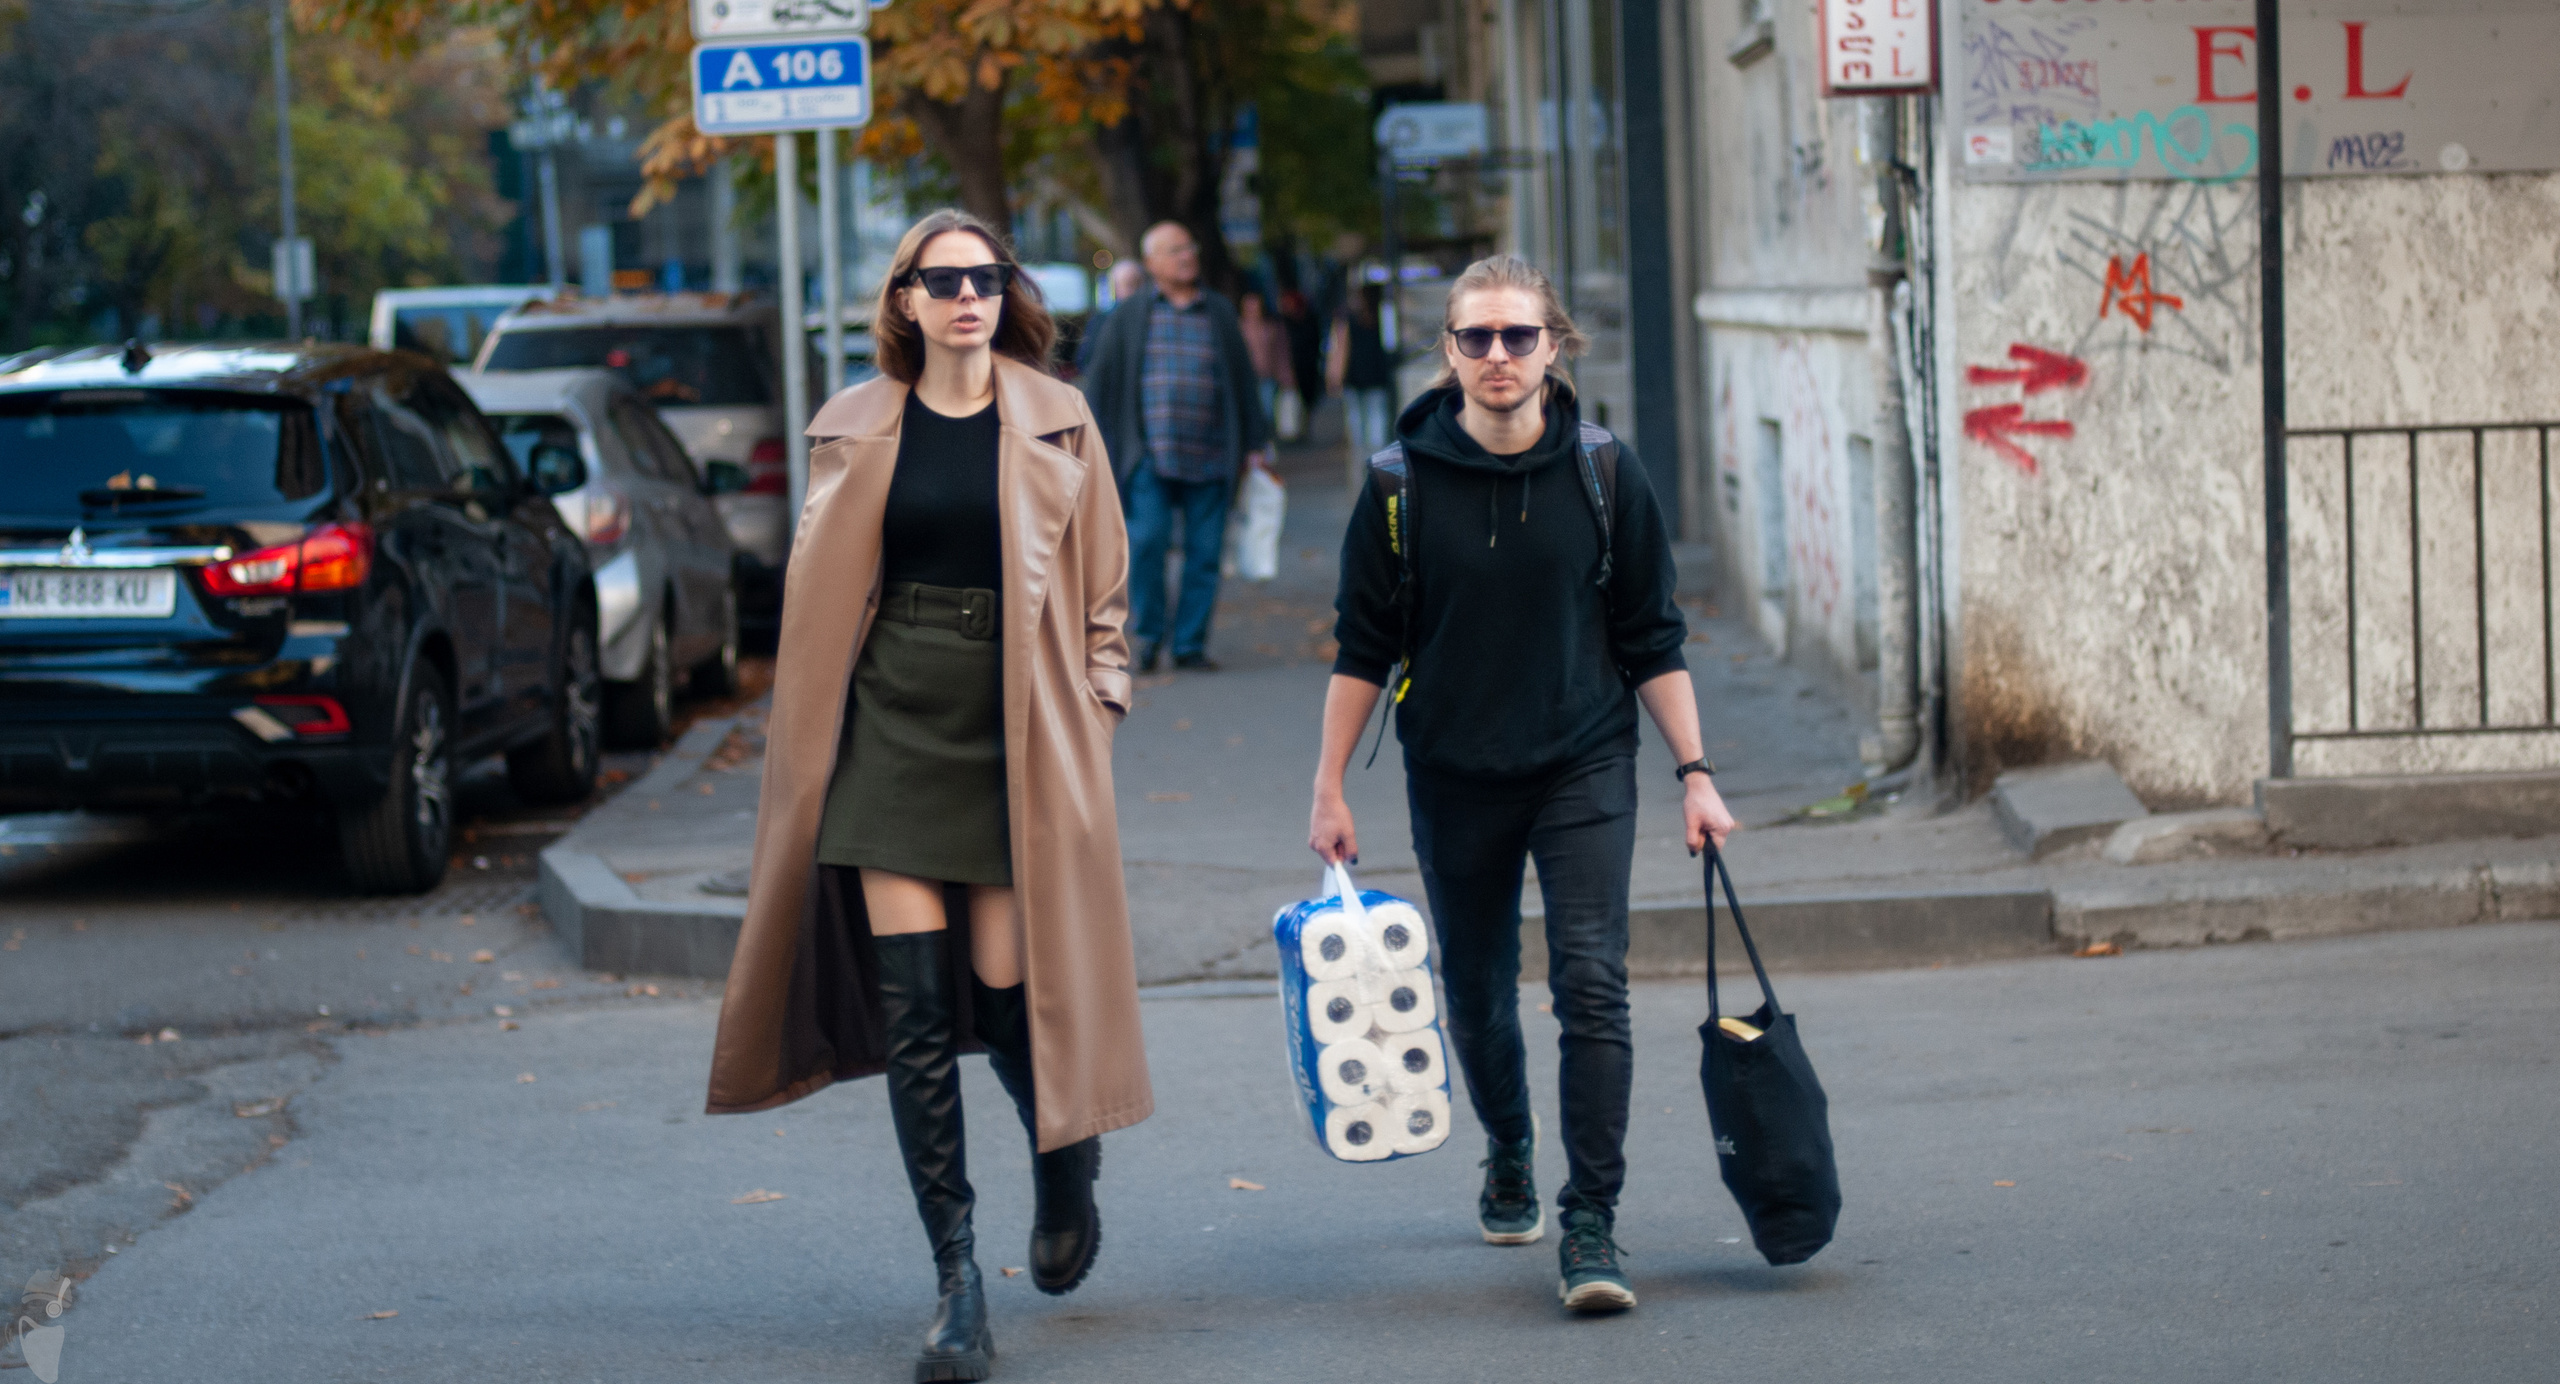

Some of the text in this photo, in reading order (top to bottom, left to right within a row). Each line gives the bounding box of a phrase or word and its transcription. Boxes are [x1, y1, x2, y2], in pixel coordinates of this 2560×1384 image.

[722, 49, 843, 89] A 106
[2190, 20, 2413, 104] E.L
[1388, 495, 1400, 554] DAKINE
